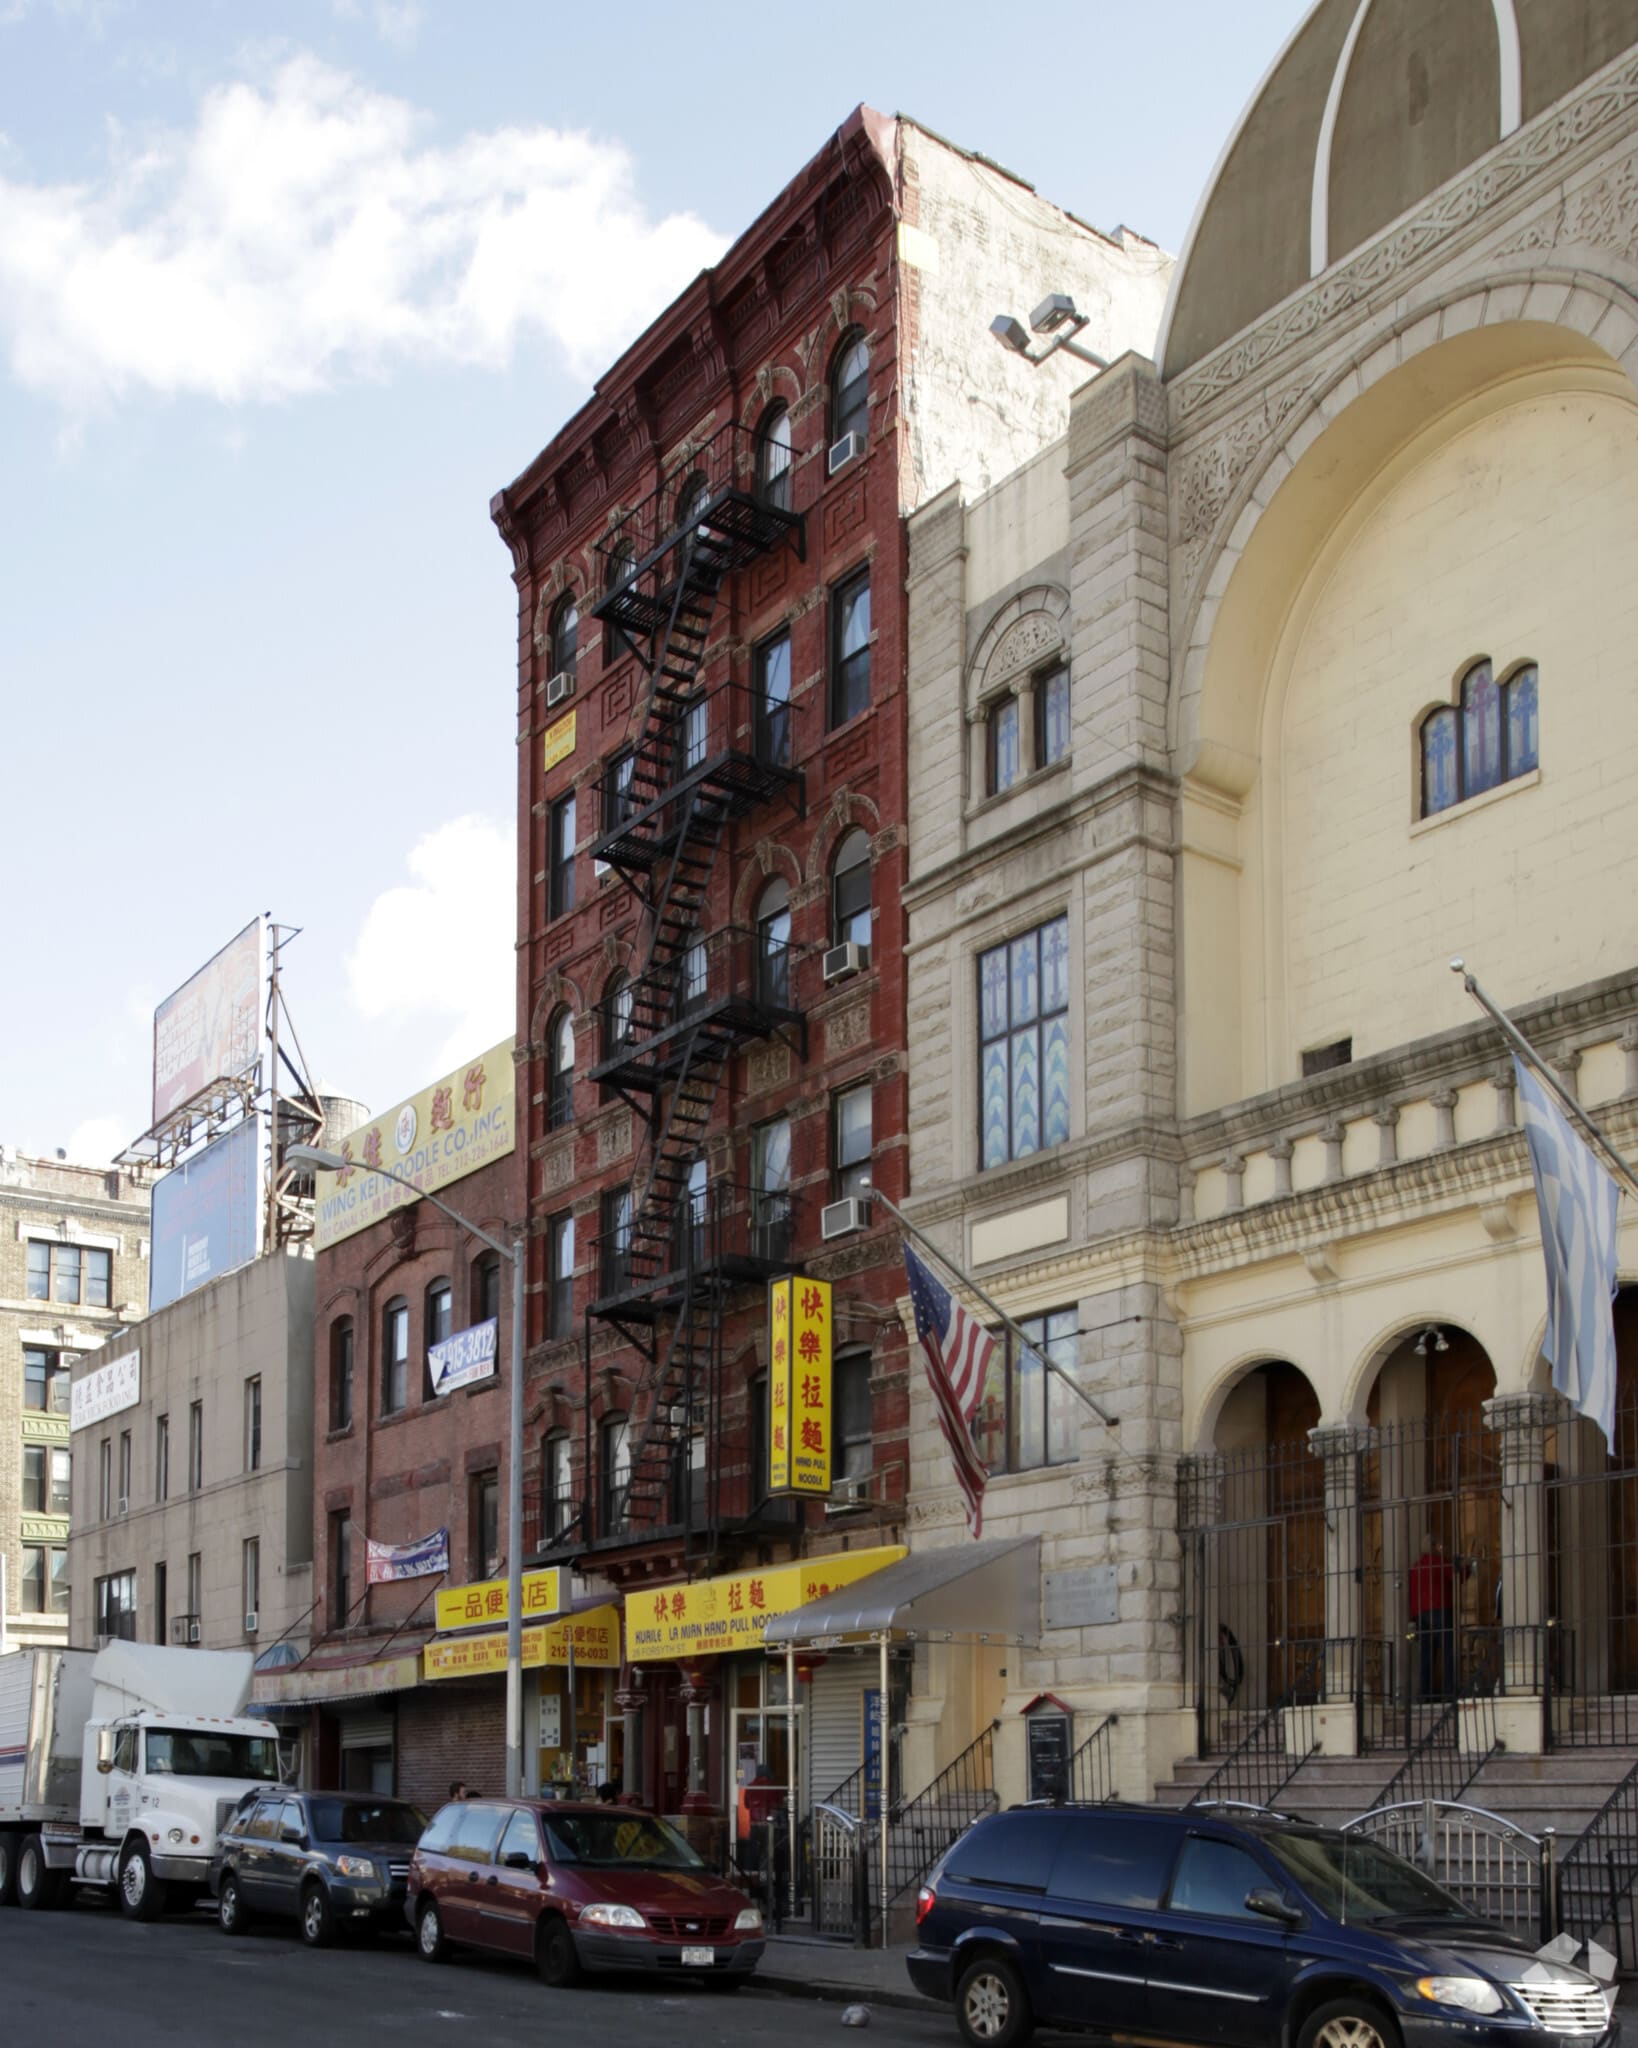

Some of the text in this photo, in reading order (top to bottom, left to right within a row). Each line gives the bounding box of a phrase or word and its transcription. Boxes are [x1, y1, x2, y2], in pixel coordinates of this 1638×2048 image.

[321, 1187, 356, 1221] WING
[360, 1175, 379, 1201] KEI
[381, 1141, 439, 1188] NOODLE
[333, 1214, 358, 1235] CANAL
[798, 1286, 826, 1454] 快樂拉麵
[795, 1456, 812, 1468] HAND
[813, 1457, 826, 1470] PULL
[798, 1472, 823, 1485] NOODLE
[445, 1581, 548, 1619] 一品便店
[653, 1579, 767, 1623] 快樂 拉麵
[635, 1629, 662, 1644] KUAILE
[668, 1625, 679, 1641] LA
[681, 1624, 702, 1639] MIAN
[704, 1619, 727, 1635] HAND
[730, 1617, 750, 1632] PULL
[642, 1644, 676, 1656] FORSYTH
[151, 1797, 160, 1809] 12
